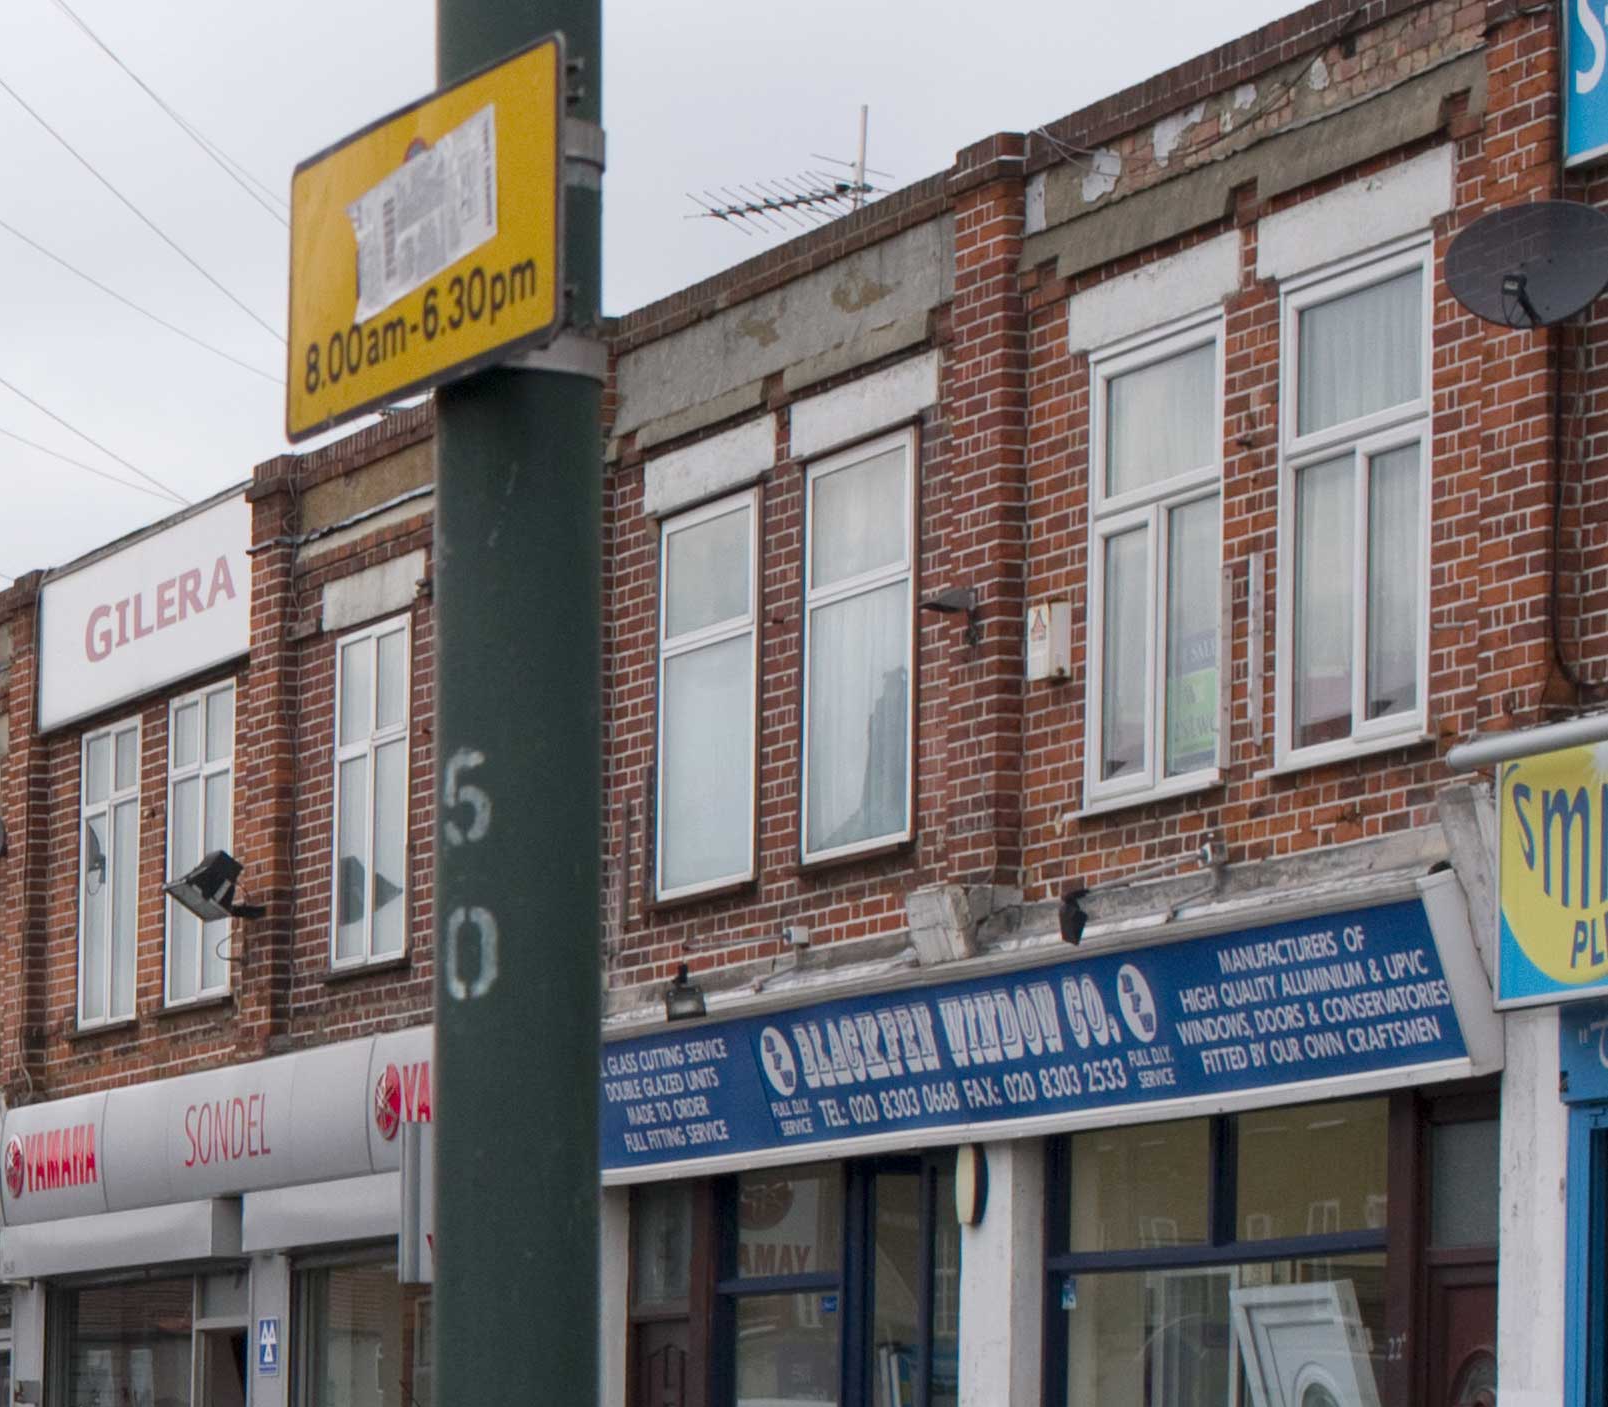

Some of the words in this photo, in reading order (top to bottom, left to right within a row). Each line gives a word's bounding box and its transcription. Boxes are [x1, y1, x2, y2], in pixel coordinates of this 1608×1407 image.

[305, 258, 537, 396] 8.00am-6.30pm
[85, 554, 237, 663] GILERA
[1217, 931, 1338, 975] MANUFACTURERS
[1343, 925, 1366, 953] OF
[1179, 986, 1216, 1014] HIGH
[1220, 975, 1277, 1007] QUALITY
[1281, 960, 1366, 997] ALUMINIUM
[1368, 957, 1381, 975] &
[1382, 949, 1429, 981] UPVC
[791, 1001, 941, 1088] BLACKFEN
[939, 981, 1064, 1068] WINDOW
[1176, 1013, 1255, 1047] WINDOWS,
[1255, 1004, 1306, 1035] DOORS
[1309, 1004, 1321, 1026] &
[1322, 979, 1451, 1024] CONSERVATORIES
[607, 1053, 638, 1076] GLASS
[639, 1045, 684, 1071] CUTTING
[685, 1038, 727, 1063] SERVICE
[1127, 1049, 1151, 1067] FULL
[1200, 1045, 1249, 1075] FITTED
[1250, 1043, 1269, 1065] BY
[1271, 1036, 1303, 1064] OUR
[1305, 1031, 1346, 1060] OWN
[1346, 1016, 1442, 1054] CRAFTSMEN
[605, 1080, 642, 1102] DOUBLE
[643, 1073, 684, 1097] GLAZED
[685, 1066, 719, 1091] UNITS
[818, 1097, 849, 1128] TEL:
[849, 1092, 880, 1123] 020
[880, 1086, 921, 1121] 8303
[922, 1081, 960, 1116] 0668
[963, 1075, 1002, 1108] FAX:
[1003, 1071, 1036, 1103] 020
[1039, 1064, 1082, 1099] 8303
[1083, 1057, 1127, 1093] 2533
[1138, 1067, 1176, 1089] SERVICE
[185, 1093, 272, 1168] SONDEL
[624, 1133, 648, 1152] FULL
[646, 1126, 686, 1149] FITTING
[686, 1119, 729, 1144] SERVICE
[626, 1104, 656, 1126] MADE
[655, 1101, 671, 1121] TO
[673, 1096, 710, 1119] ORDER
[771, 1101, 792, 1118] FULL
[781, 1117, 814, 1136] SERVICE
[25, 1122, 98, 1193] YAMAHA
